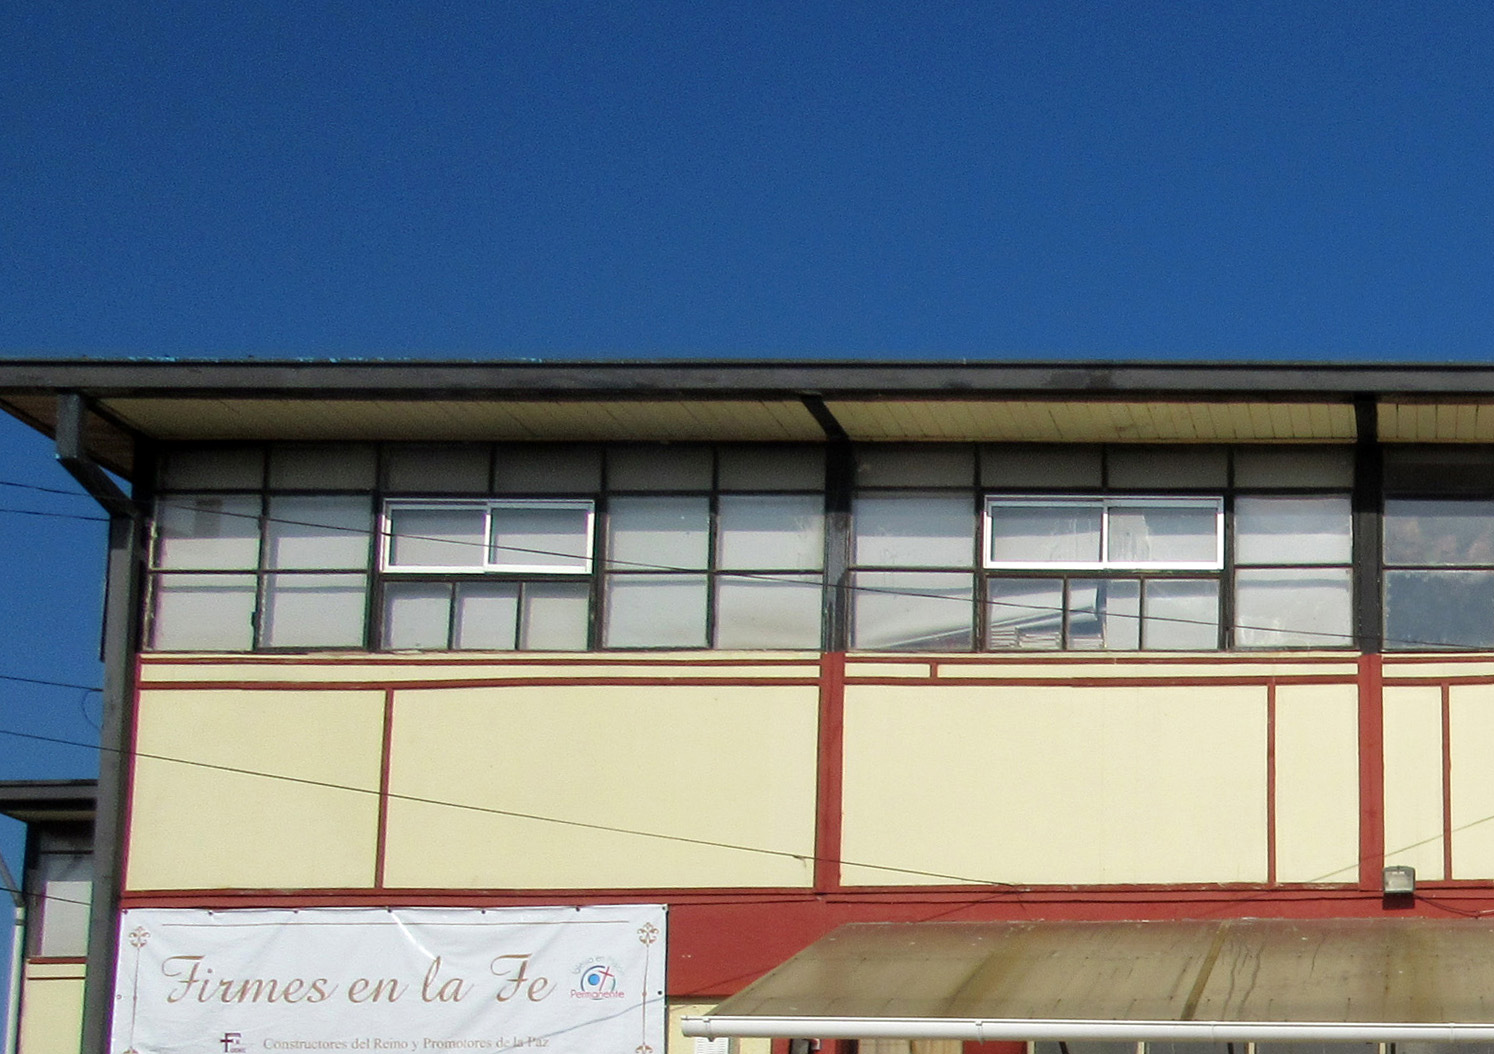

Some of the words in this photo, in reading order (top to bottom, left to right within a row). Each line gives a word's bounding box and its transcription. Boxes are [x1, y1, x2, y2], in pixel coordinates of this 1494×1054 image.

[161, 954, 339, 1004] Firmes
[347, 977, 409, 1004] en
[421, 955, 475, 1003] la
[490, 953, 557, 1002] Fe
[263, 1037, 347, 1050] Constructores
[351, 1037, 370, 1049] del
[373, 1037, 408, 1049] Reino
[411, 1040, 419, 1051] y
[423, 1037, 492, 1049] Promotores
[496, 1036, 510, 1048] de
[513, 1036, 524, 1048] la
[527, 1036, 550, 1048] Paz
